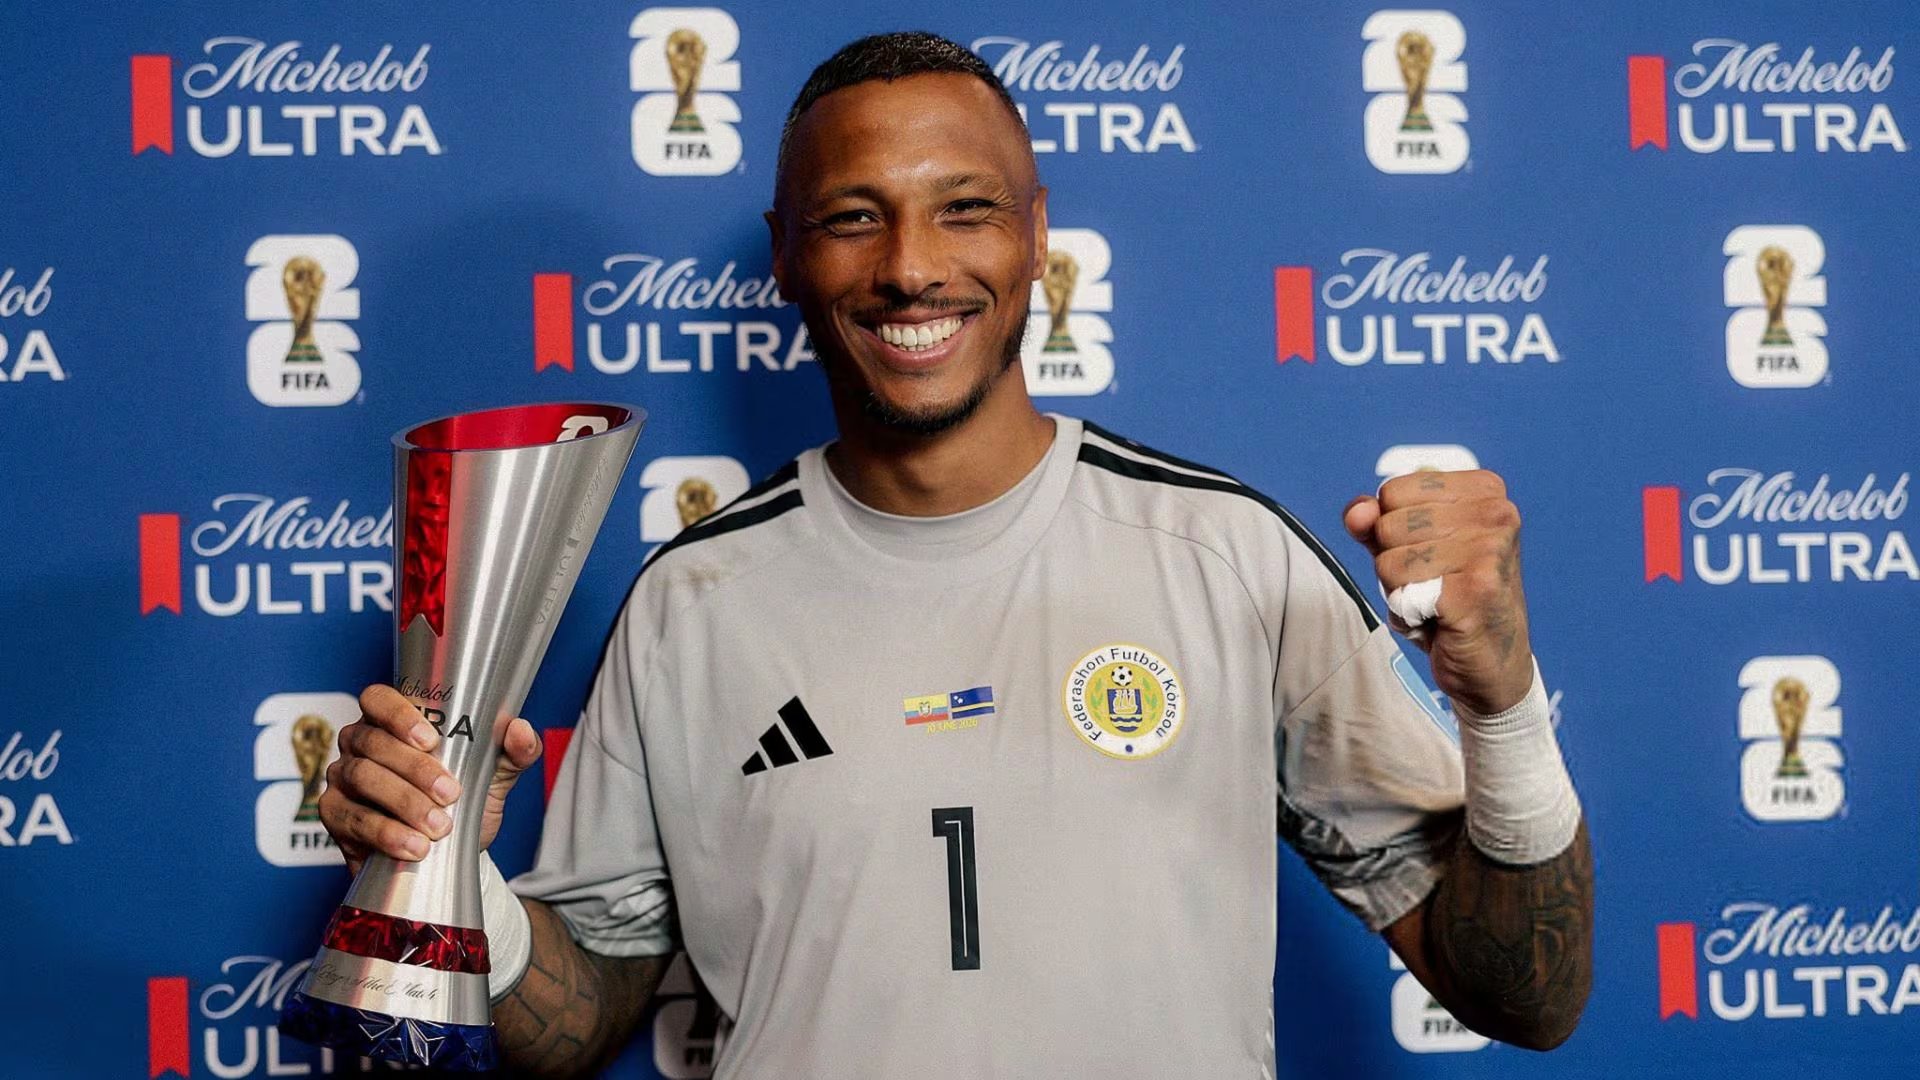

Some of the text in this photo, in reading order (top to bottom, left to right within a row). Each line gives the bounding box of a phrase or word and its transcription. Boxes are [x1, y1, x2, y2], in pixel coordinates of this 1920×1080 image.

[183, 36, 432, 99] Michelob
[970, 36, 1186, 92] Michelob
[1674, 38, 1894, 98] Michelob
[187, 104, 441, 158] ULTRA
[664, 142, 711, 160] FIFA
[1016, 102, 1197, 154] LTRA
[1396, 142, 1441, 159] FIFA
[1678, 102, 1904, 154] ULTRA
[583, 253, 788, 317] Michel
[1322, 247, 1549, 310] Michelob
[1325, 313, 1559, 366] ULTRA
[1756, 355, 1800, 372] FIFA
[281, 371, 330, 389] FIFA
[1039, 362, 1084, 378] FIFA
[191, 492, 394, 557] Michel
[1688, 467, 1910, 529] Michelob
[1693, 531, 1920, 586] ULTRA
[194, 560, 394, 617] ULTR
[1071, 655, 1106, 741] Federashon
[1772, 786, 1816, 803] FIFA
[931, 806, 981, 971] 1
[1704, 902, 1920, 965] Michelob
